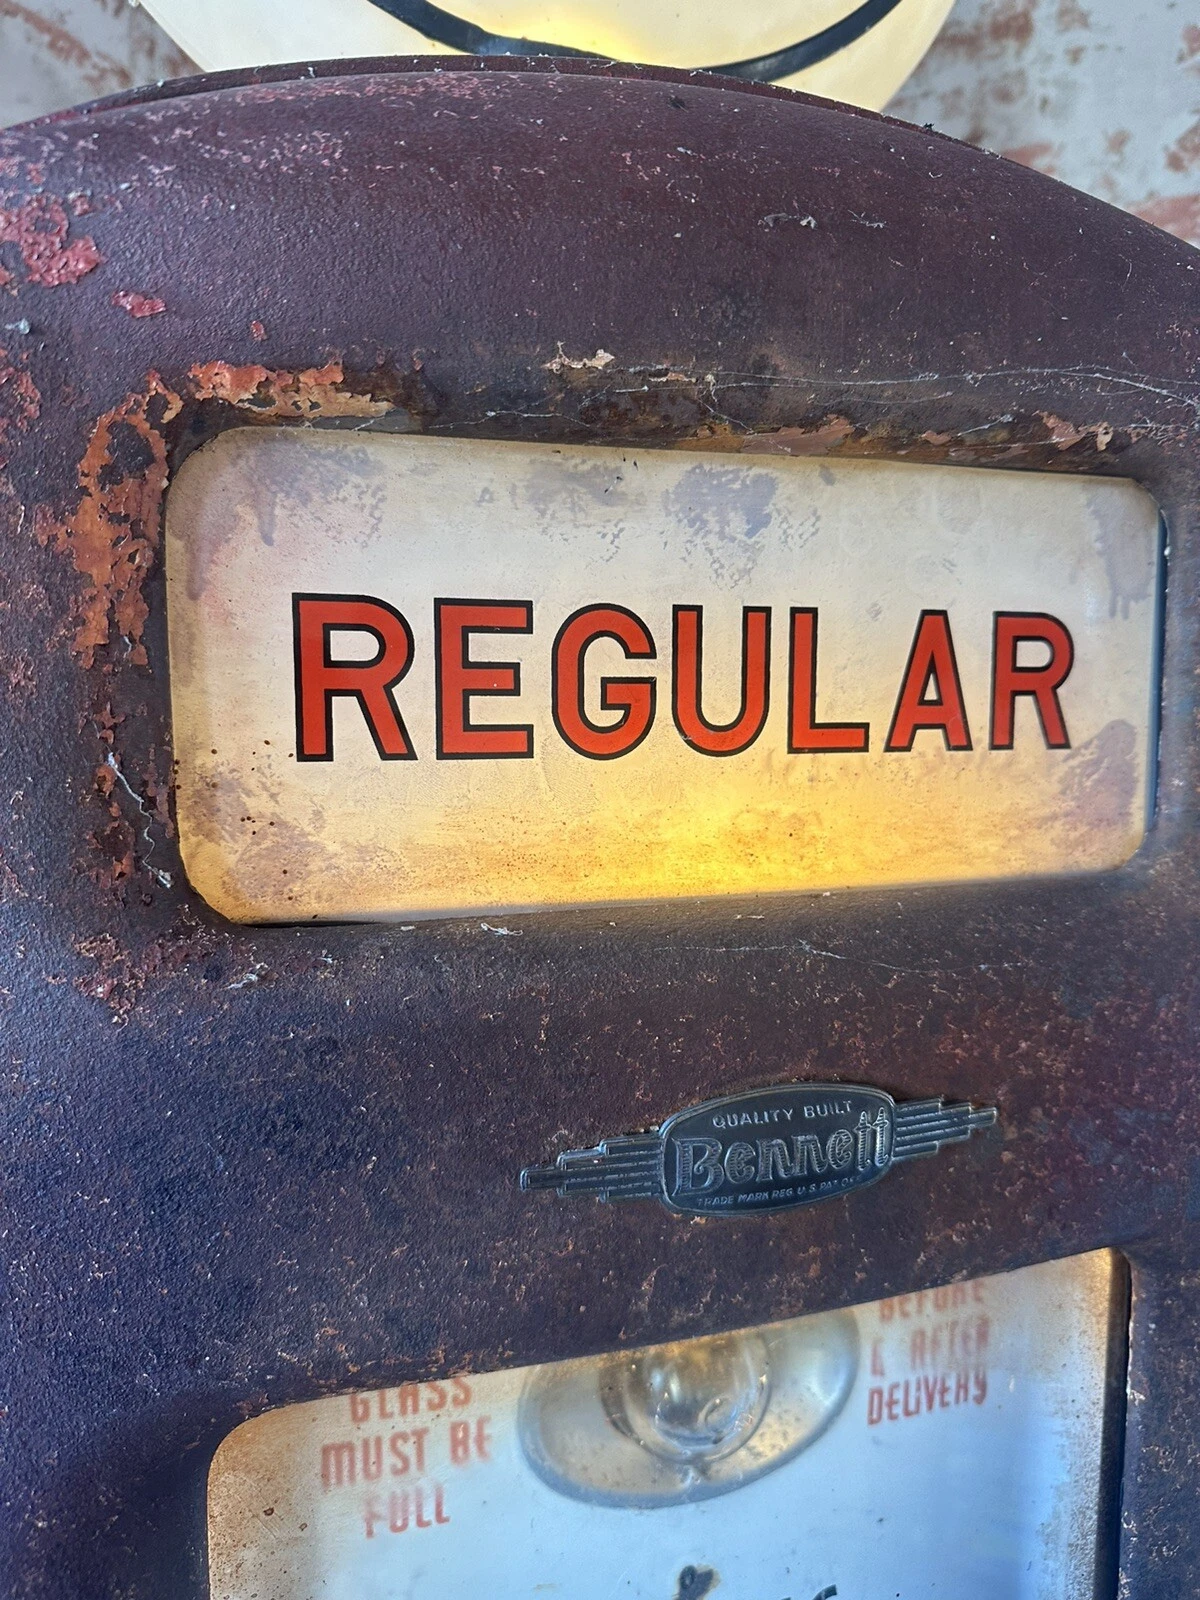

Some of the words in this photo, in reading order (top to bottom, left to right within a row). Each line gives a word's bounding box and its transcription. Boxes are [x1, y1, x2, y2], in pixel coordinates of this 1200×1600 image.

[292, 592, 1076, 762] REGULAR
[713, 1108, 793, 1129] QUALITY
[804, 1100, 852, 1118] BUILT
[671, 1107, 889, 1196] Bennett
[738, 1192, 769, 1202] MARK
[772, 1188, 793, 1198] REG
[350, 1377, 472, 1423] GLASS
[867, 1365, 988, 1425] DELIVERY
[321, 1427, 429, 1490] MUST
[450, 1415, 491, 1464] BE
[365, 1484, 450, 1539] FULL
